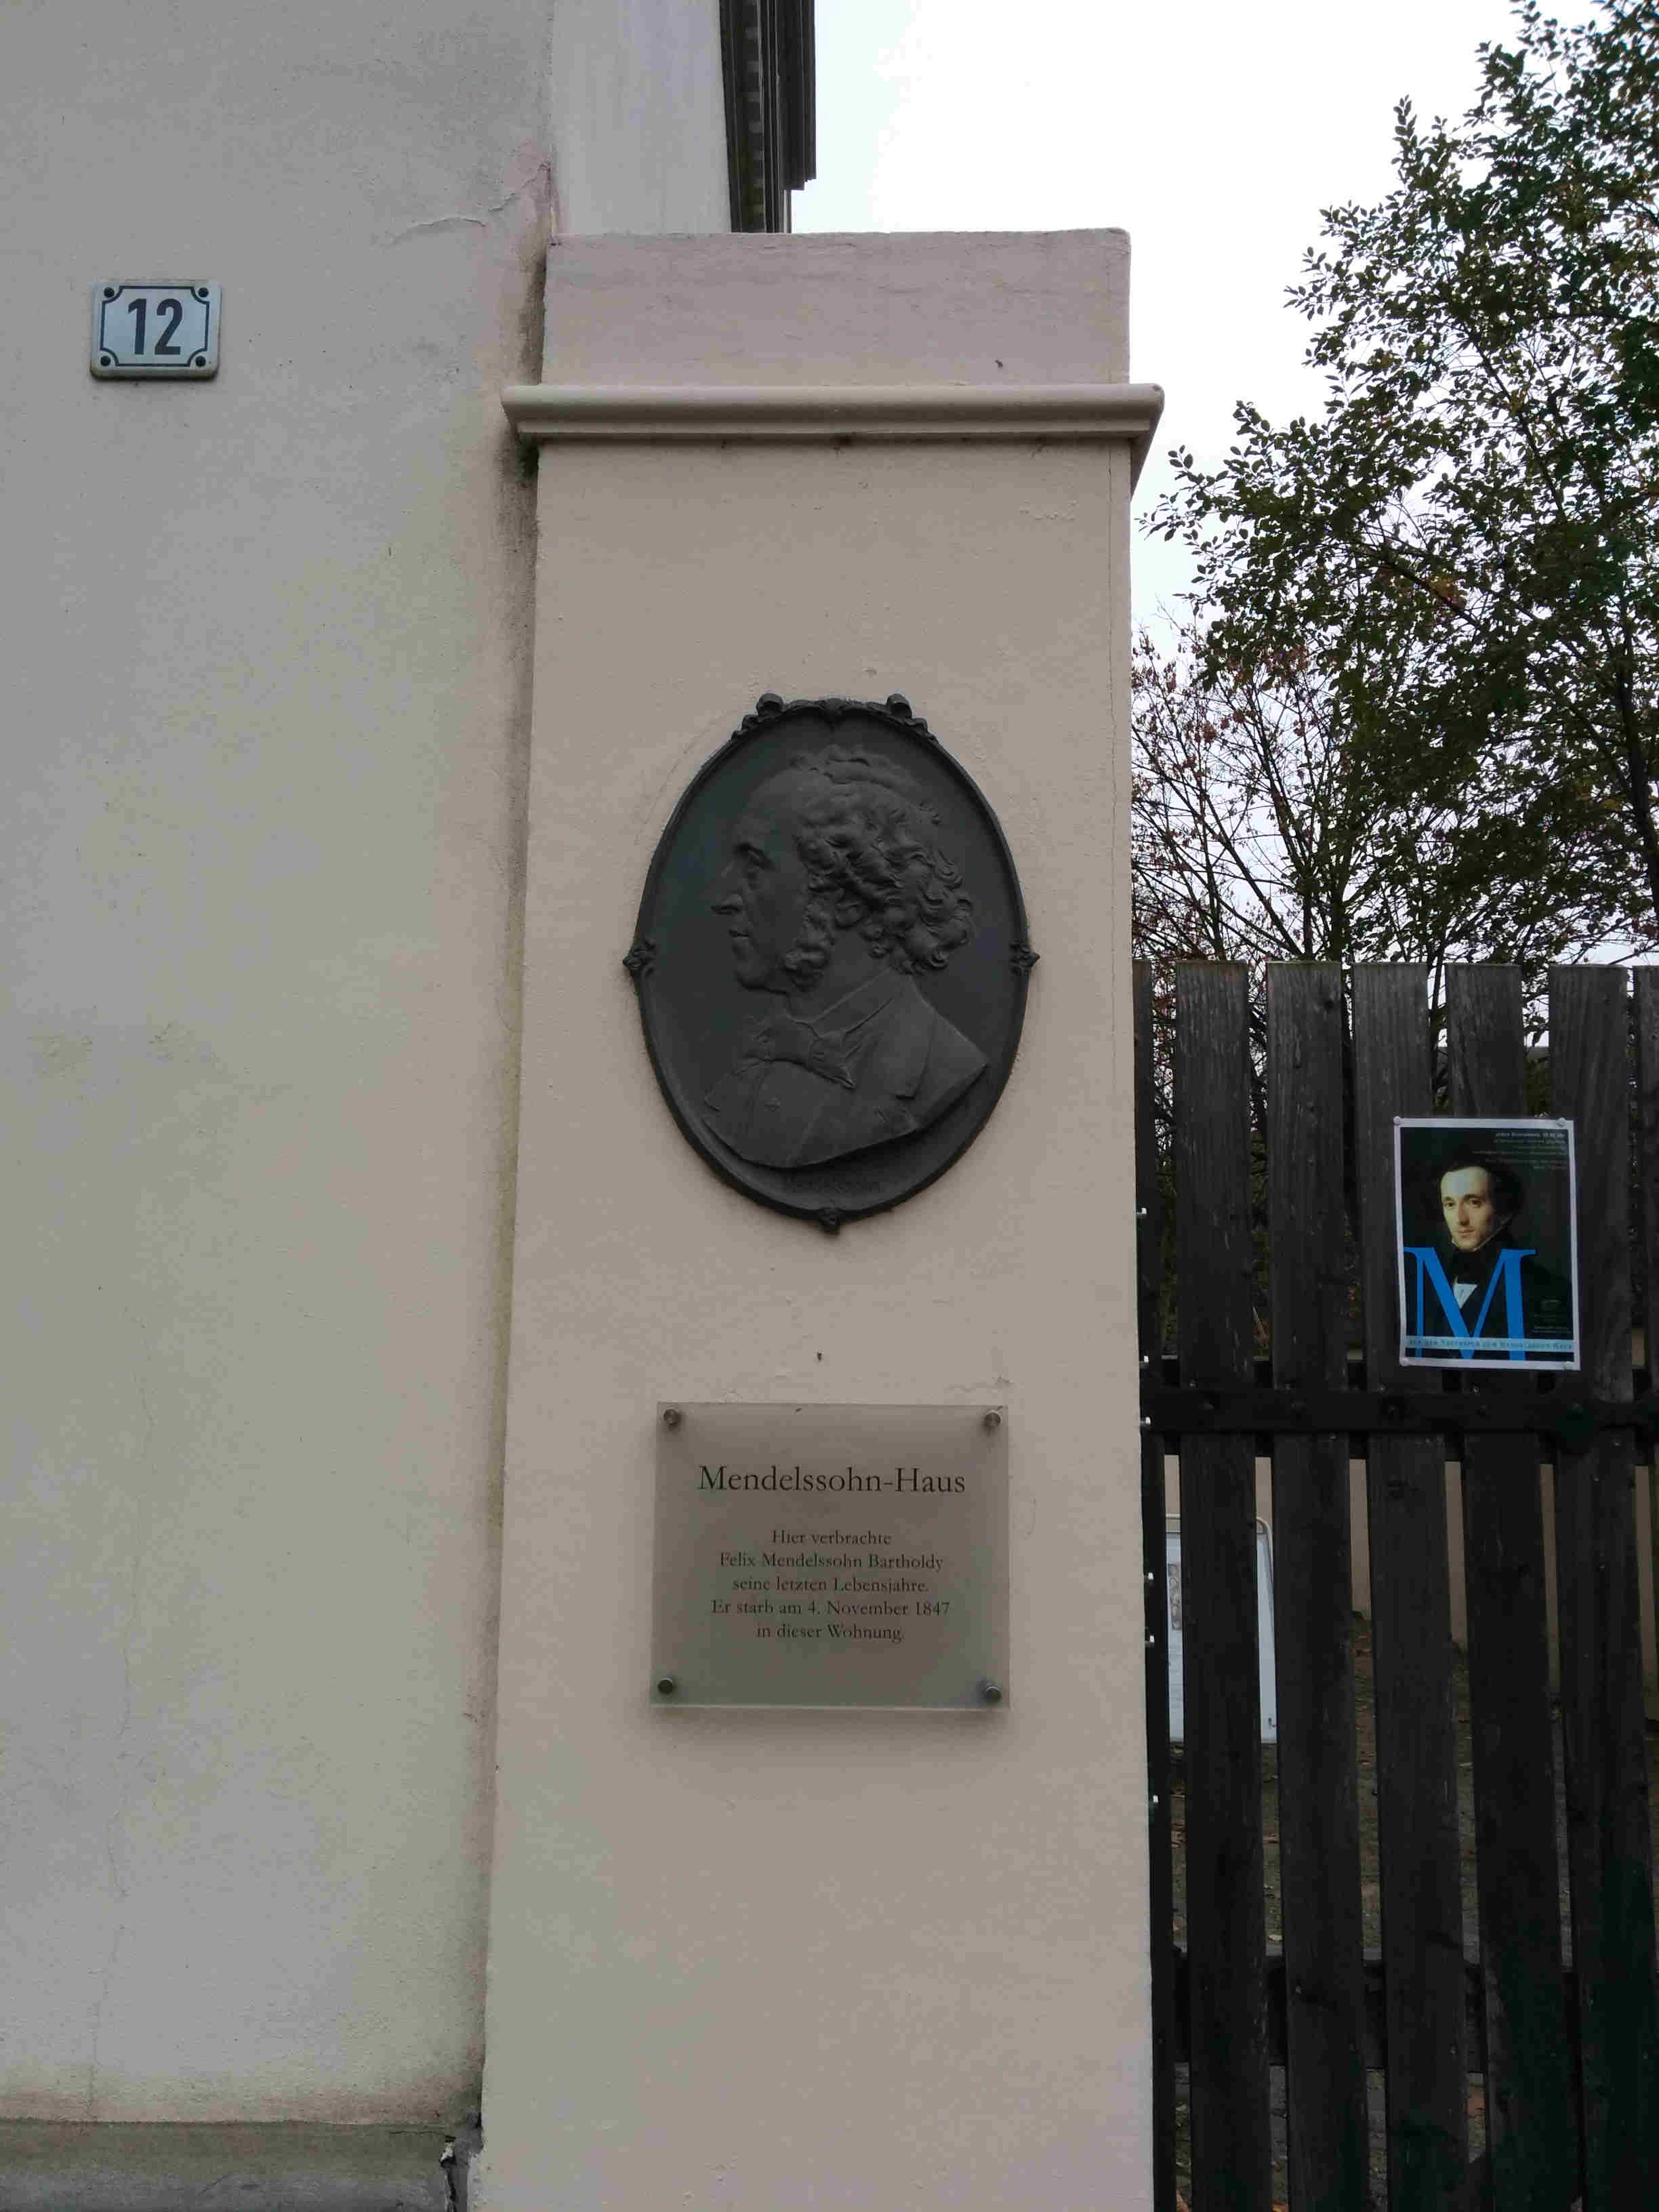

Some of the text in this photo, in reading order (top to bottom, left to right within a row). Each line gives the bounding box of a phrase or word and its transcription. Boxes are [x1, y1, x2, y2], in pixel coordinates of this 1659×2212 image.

[127, 298, 183, 355] 12
[1403, 1246, 1537, 1361] M
[698, 1465, 966, 1492] Mendelssohn-Haus
[771, 1530, 892, 1545] Hier verbrachte
[720, 1551, 943, 1572] Felix Mendelssohn Bartholdy
[732, 1576, 928, 1594] seine letzten Lebensjahre.
[710, 1600, 949, 1616] Er starb am 4. November 1847
[757, 1624, 771, 1638] in
[777, 1624, 821, 1639] dieser
